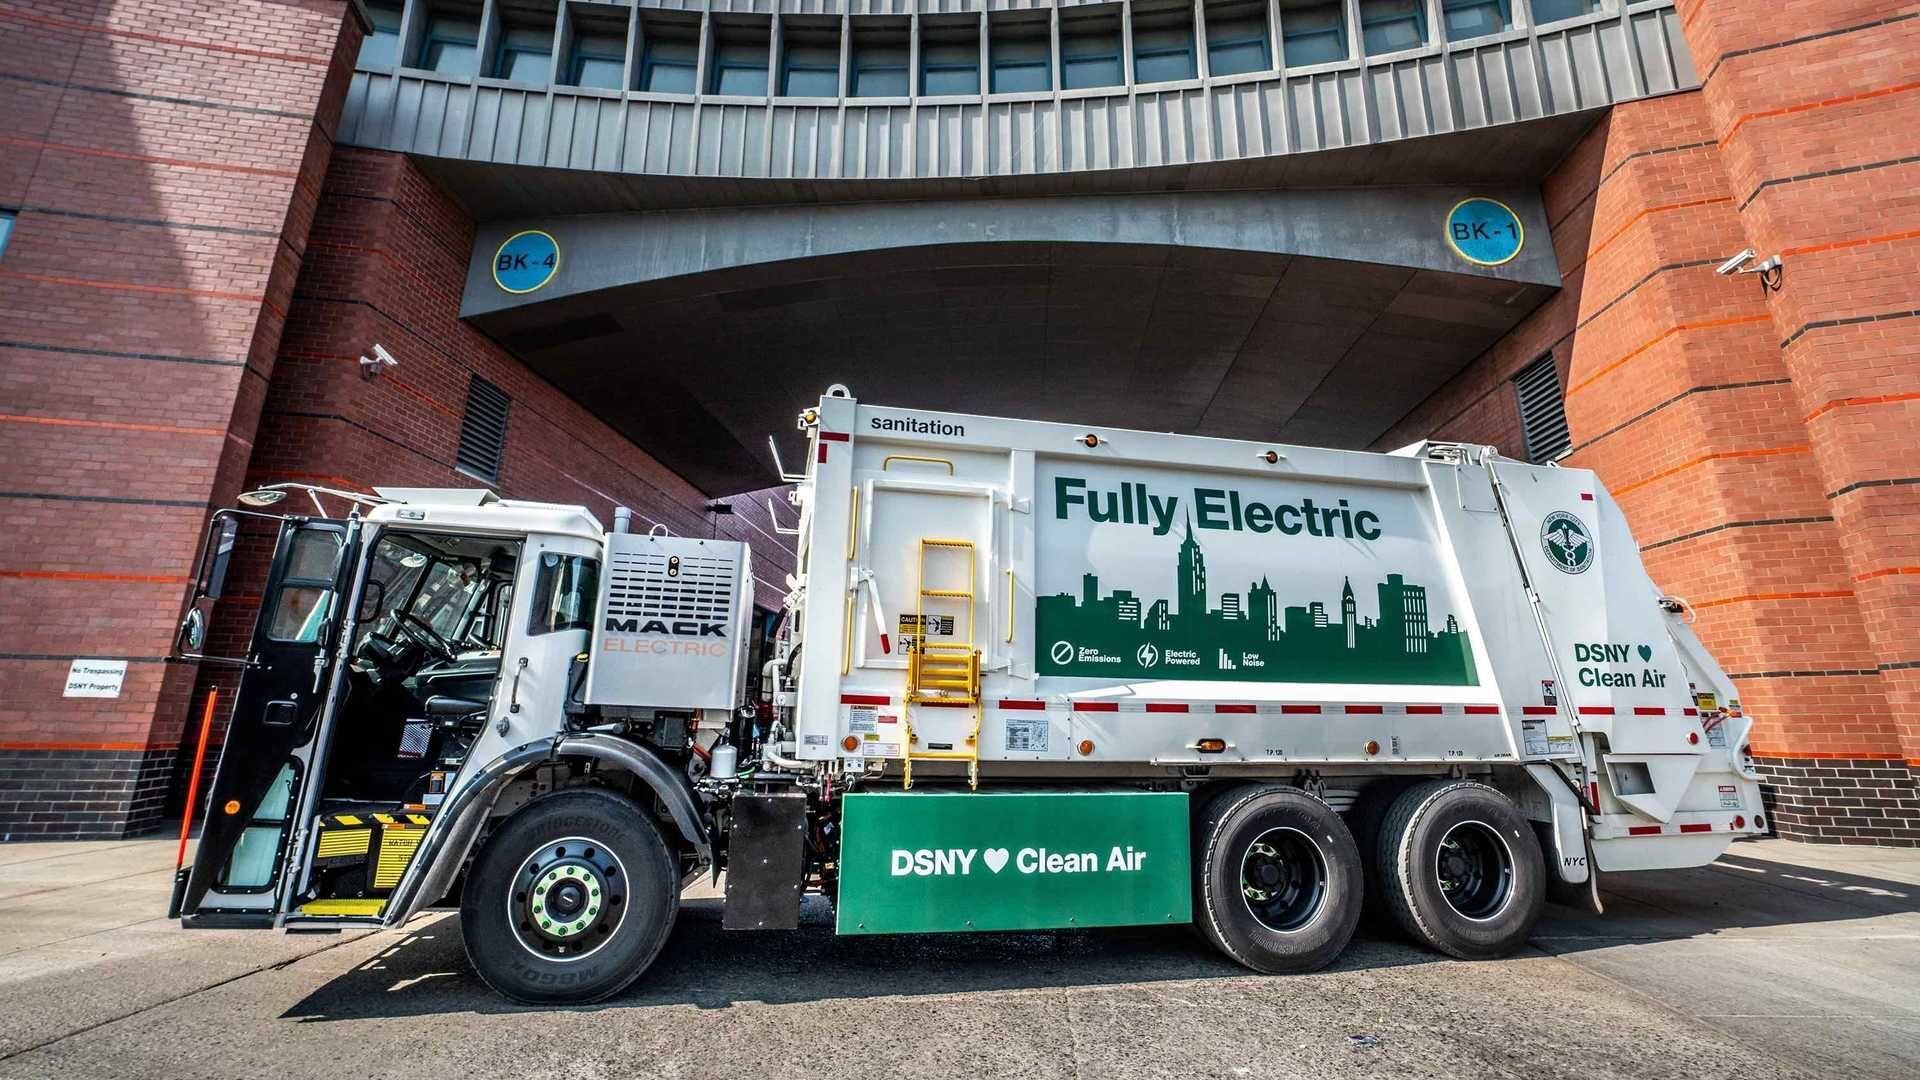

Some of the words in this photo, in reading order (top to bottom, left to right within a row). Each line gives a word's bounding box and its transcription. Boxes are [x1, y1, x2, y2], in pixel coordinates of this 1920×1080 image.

[1453, 221, 1517, 240] BK-1
[498, 253, 556, 271] BK-4
[871, 417, 965, 437] sanitation
[1054, 476, 1179, 536] Fully
[1193, 487, 1382, 541] Electric
[605, 618, 728, 638] MACK
[603, 638, 727, 657] ELECTRIC
[1079, 646, 1099, 655] Zero
[1165, 649, 1197, 658] Electric
[1574, 643, 1630, 663] DSNY
[1078, 654, 1122, 663] Emissions
[1165, 657, 1201, 666] Powered
[1242, 652, 1259, 660] Low
[1242, 659, 1265, 667] Noise
[83, 667, 123, 676] Trespassing
[1578, 667, 1636, 688] Clean
[1642, 669, 1666, 688] Air
[89, 683, 118, 691] Property
[891, 848, 978, 876] DSNY
[1016, 847, 1098, 874] Clean
[1106, 846, 1147, 872] Air
[1564, 857, 1586, 867] NYC
